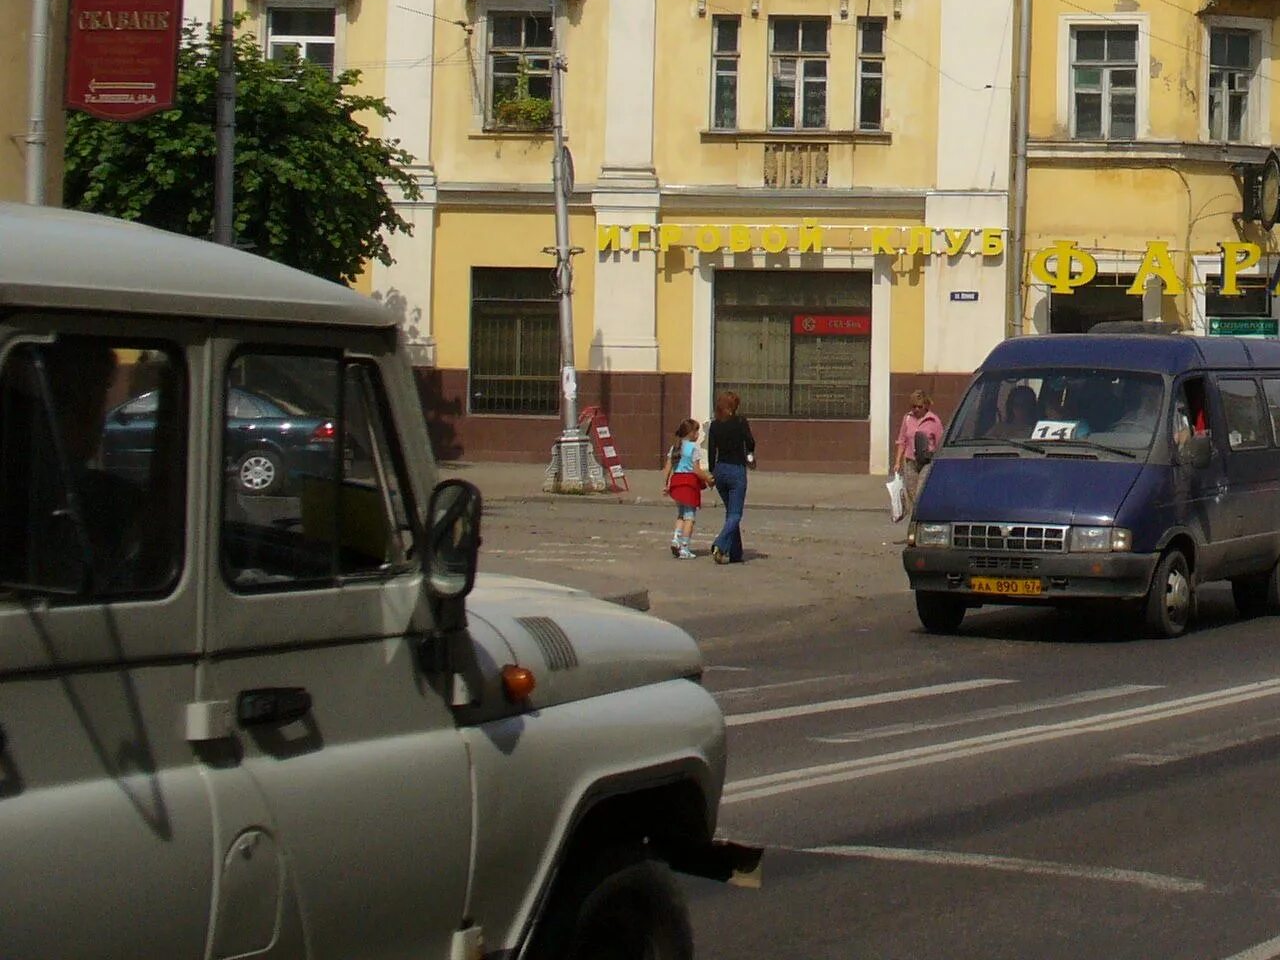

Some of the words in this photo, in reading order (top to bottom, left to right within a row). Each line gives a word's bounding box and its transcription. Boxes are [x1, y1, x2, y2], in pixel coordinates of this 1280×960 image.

[115, 11, 169, 30] БАНК
[598, 218, 824, 254] ИГРОВОЙ
[872, 226, 1005, 256] КЛУБ
[1037, 426, 1067, 440] 14
[996, 581, 1018, 592] 890
